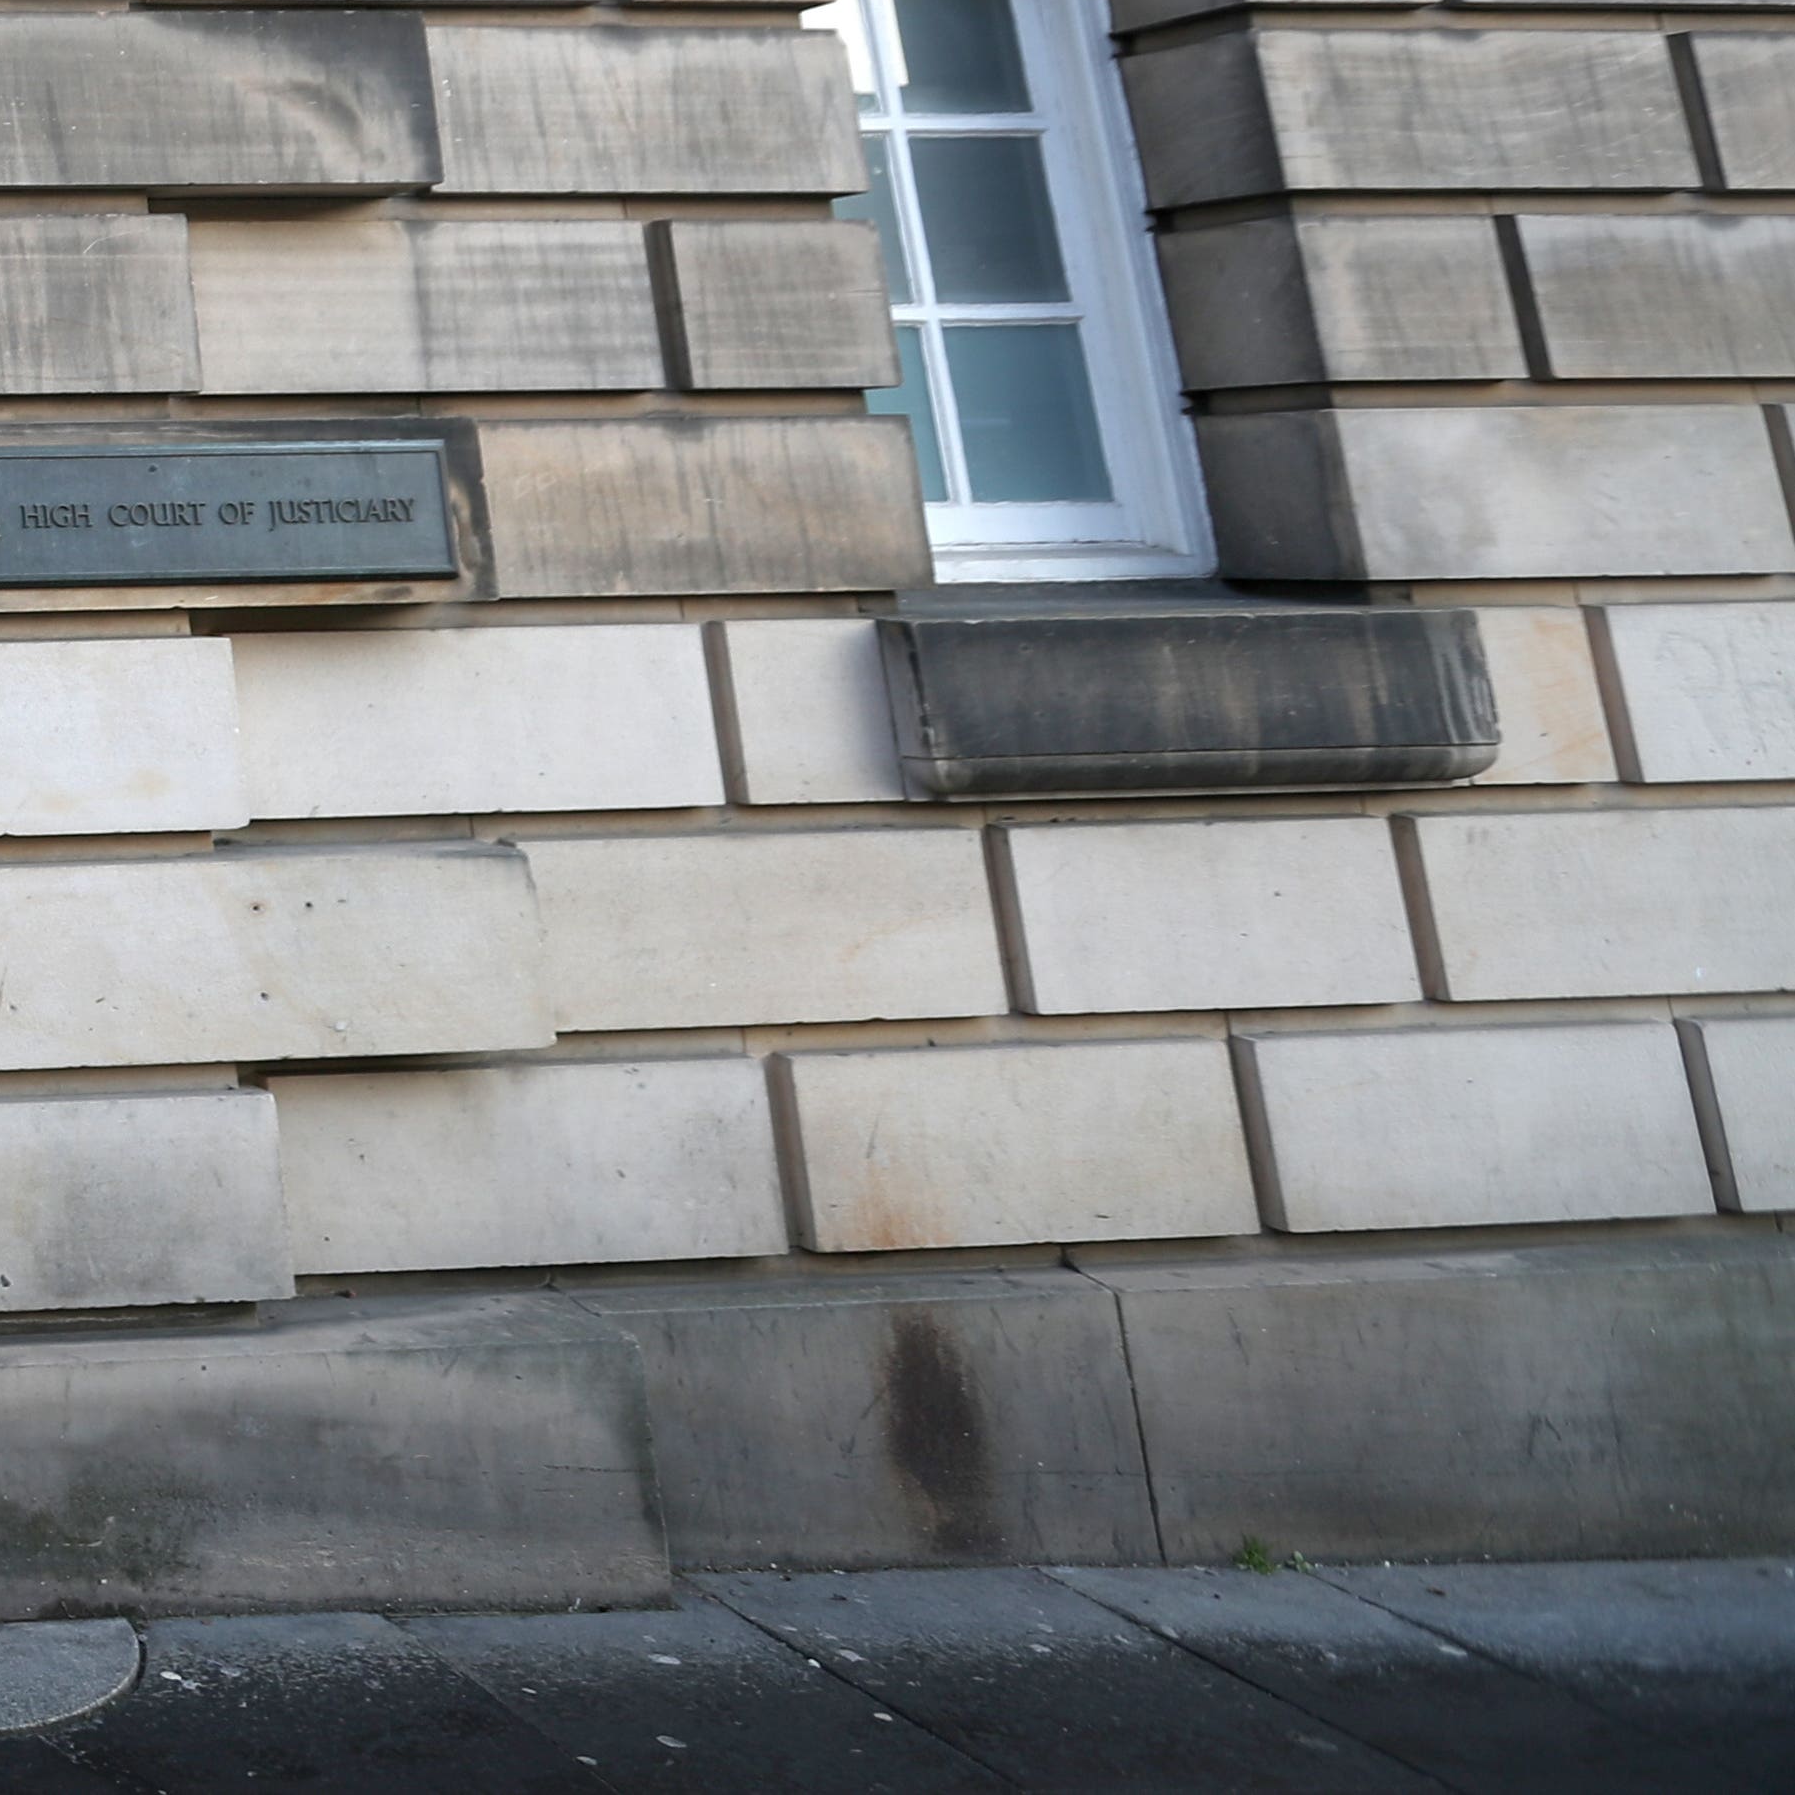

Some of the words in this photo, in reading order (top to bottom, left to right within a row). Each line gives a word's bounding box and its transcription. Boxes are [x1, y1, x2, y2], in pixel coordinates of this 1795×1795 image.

[20, 503, 93, 529] HIGH
[107, 501, 206, 527] COURT
[218, 500, 255, 526] OF
[268, 498, 415, 532] JUSTICIARY
